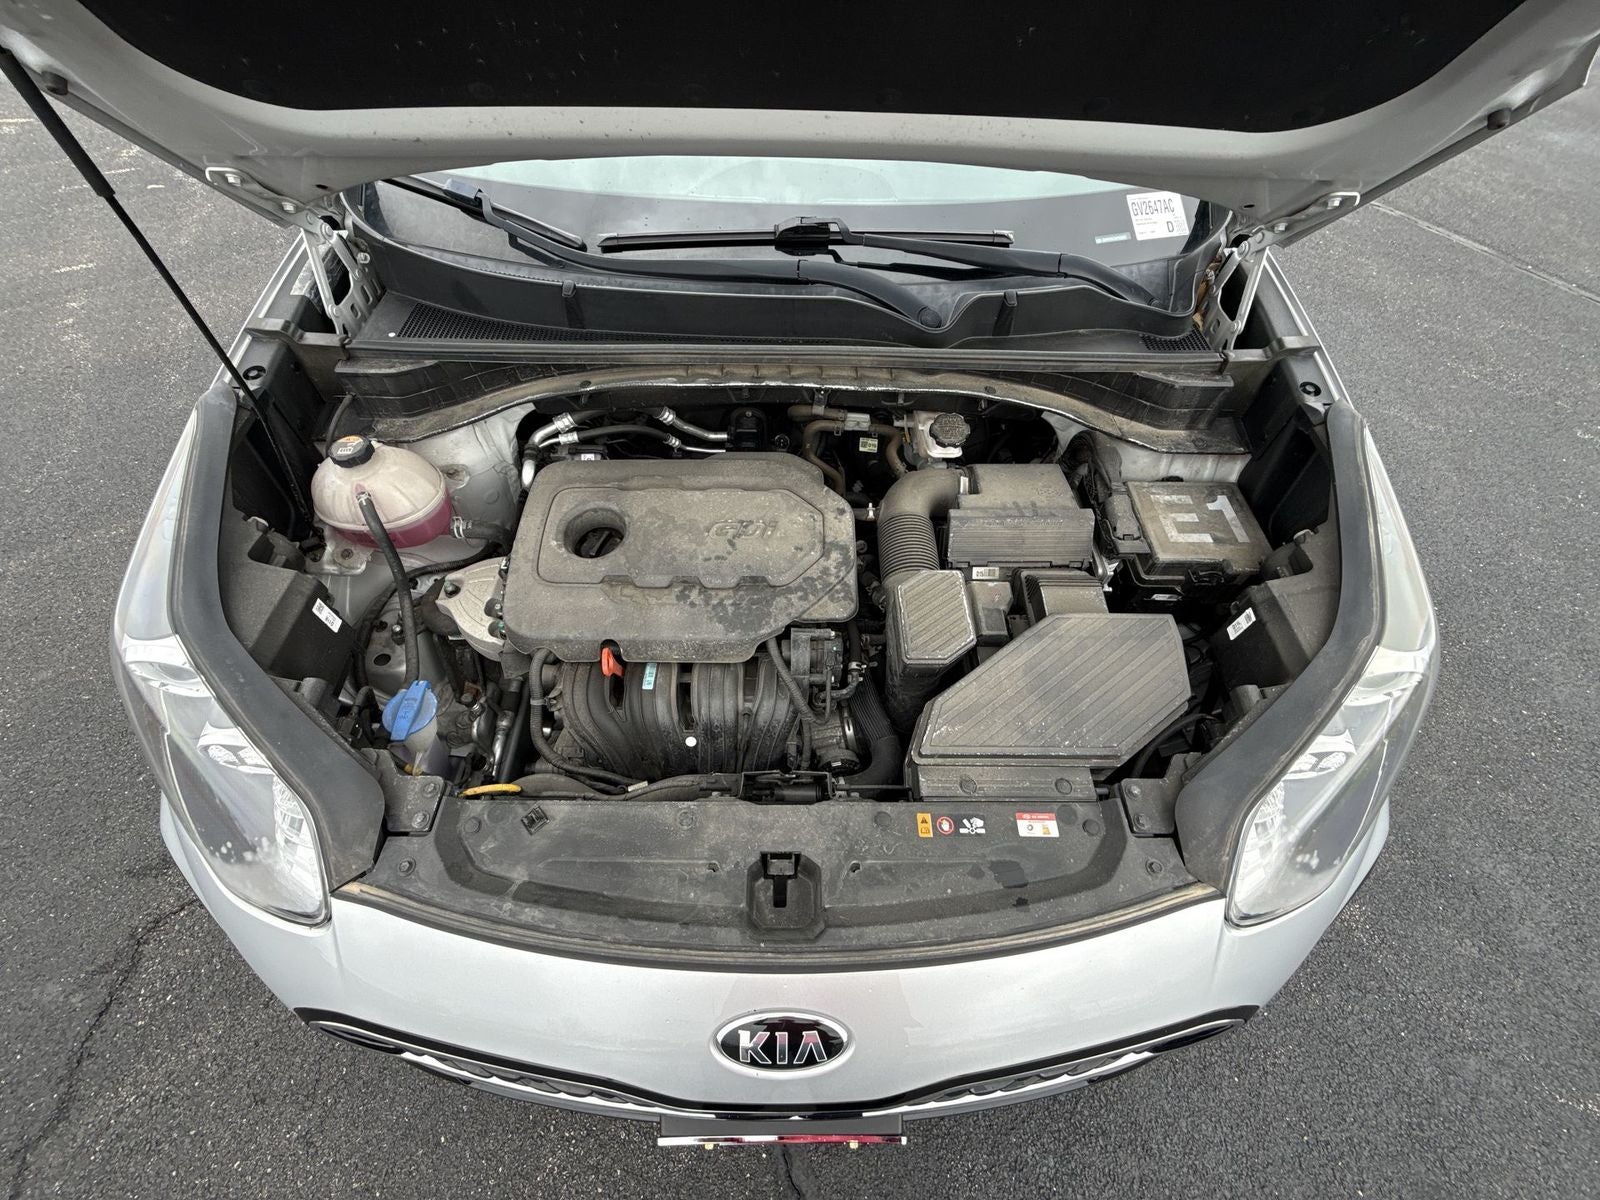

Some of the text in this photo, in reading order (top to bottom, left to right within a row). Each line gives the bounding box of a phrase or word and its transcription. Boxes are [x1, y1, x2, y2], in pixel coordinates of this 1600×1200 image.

[1131, 198, 1175, 216] GV2647AC
[1166, 220, 1175, 233] D
[738, 1029, 828, 1064] KIA
